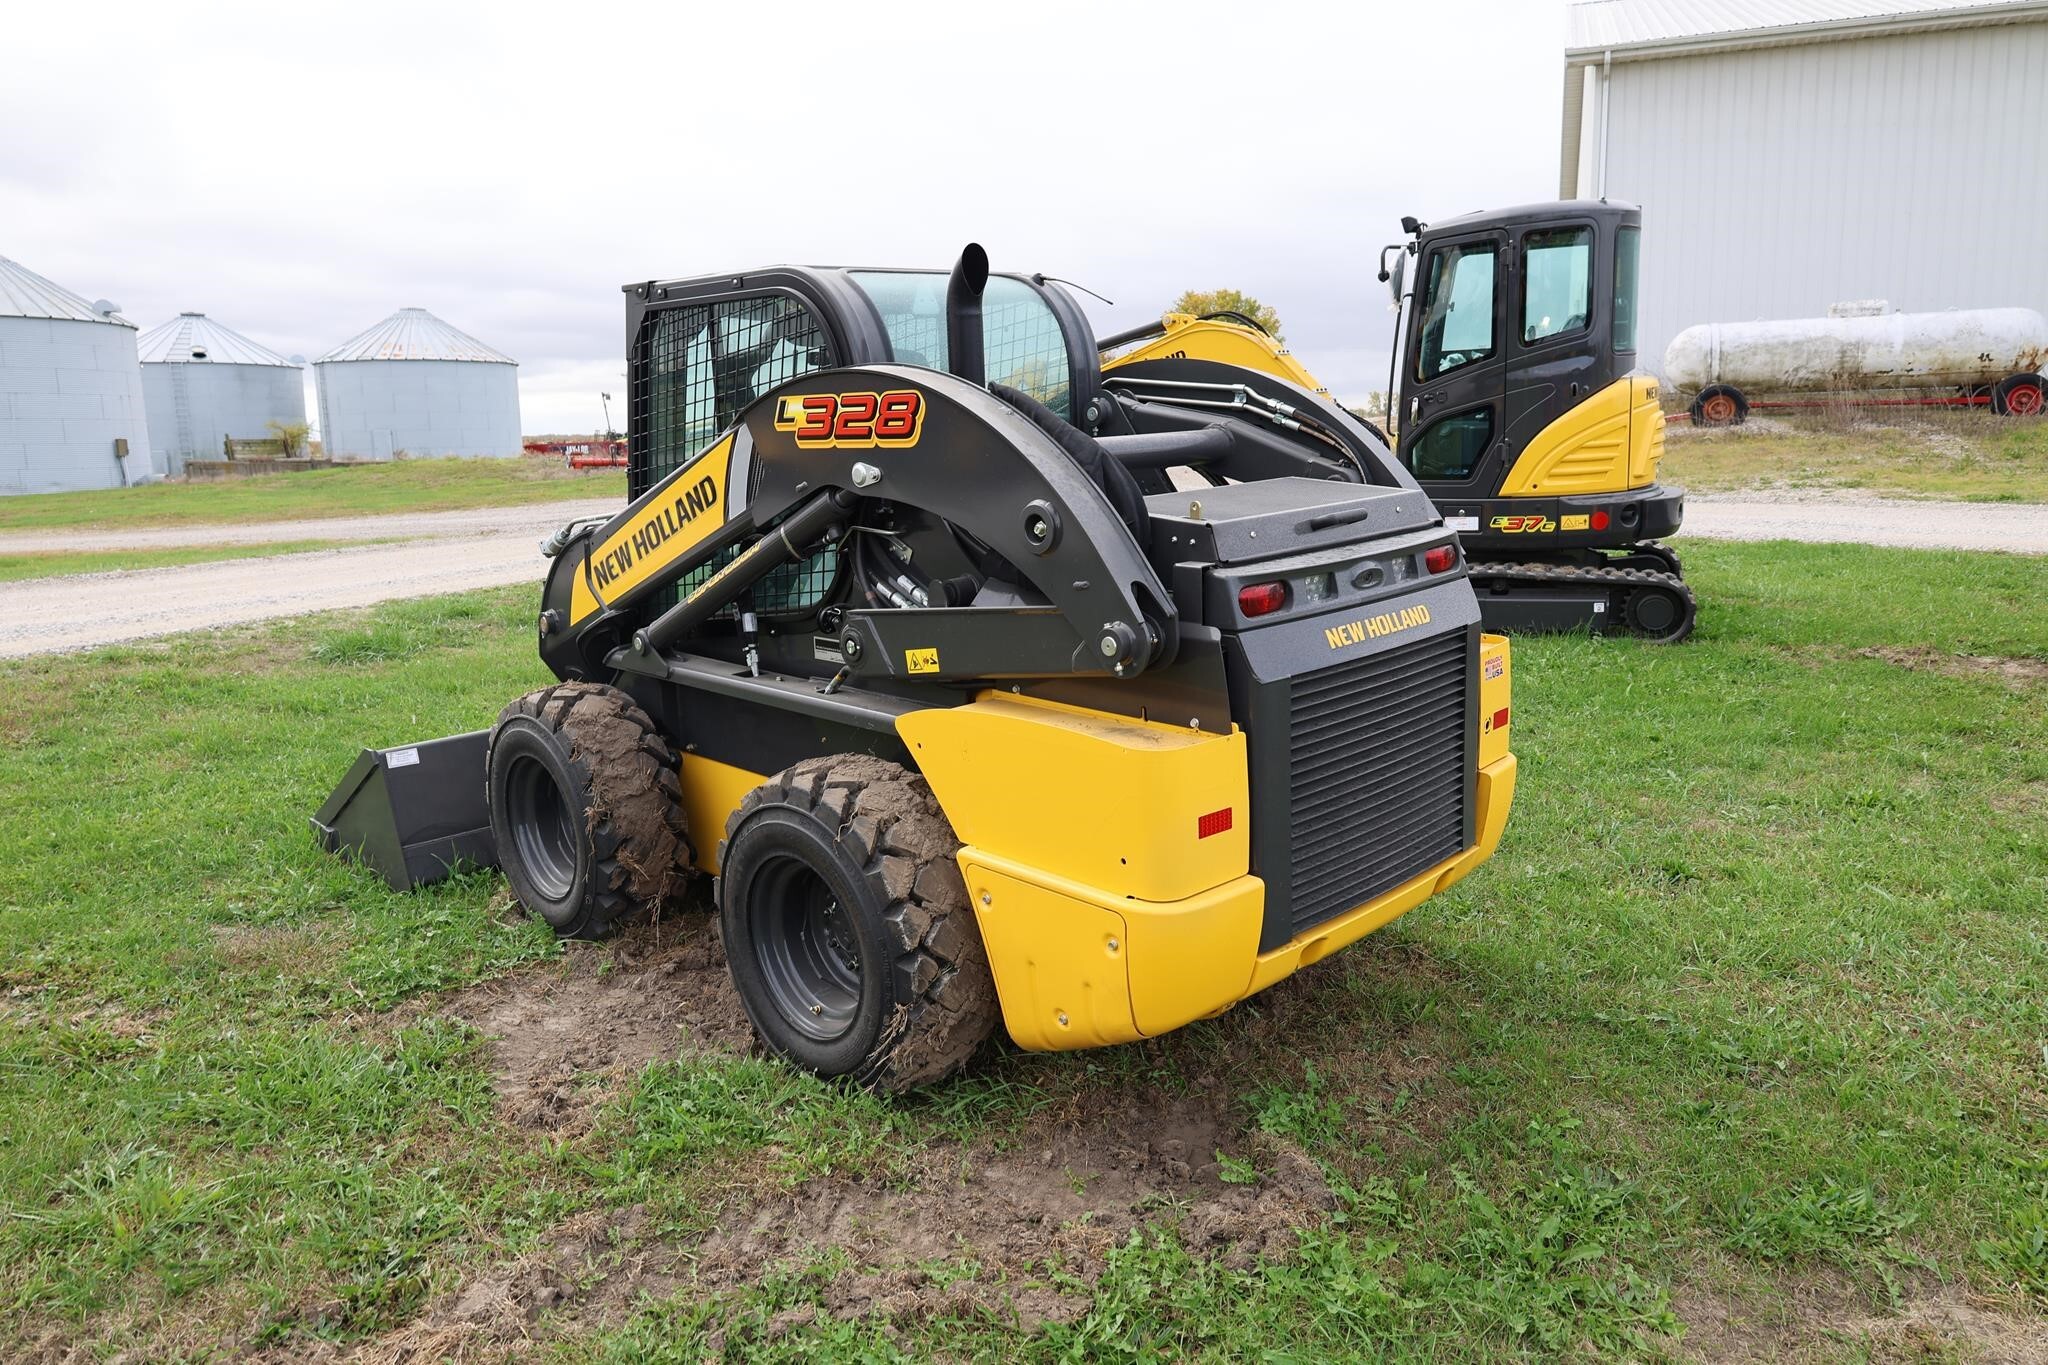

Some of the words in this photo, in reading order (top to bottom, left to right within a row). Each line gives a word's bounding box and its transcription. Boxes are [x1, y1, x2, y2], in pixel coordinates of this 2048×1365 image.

[1646, 386, 1657, 400] NE
[775, 391, 925, 447] L328
[593, 541, 633, 590] NEW
[631, 475, 718, 560] HOLLAND
[1324, 620, 1366, 650] NEW
[1364, 604, 1432, 639] HOLLAND
